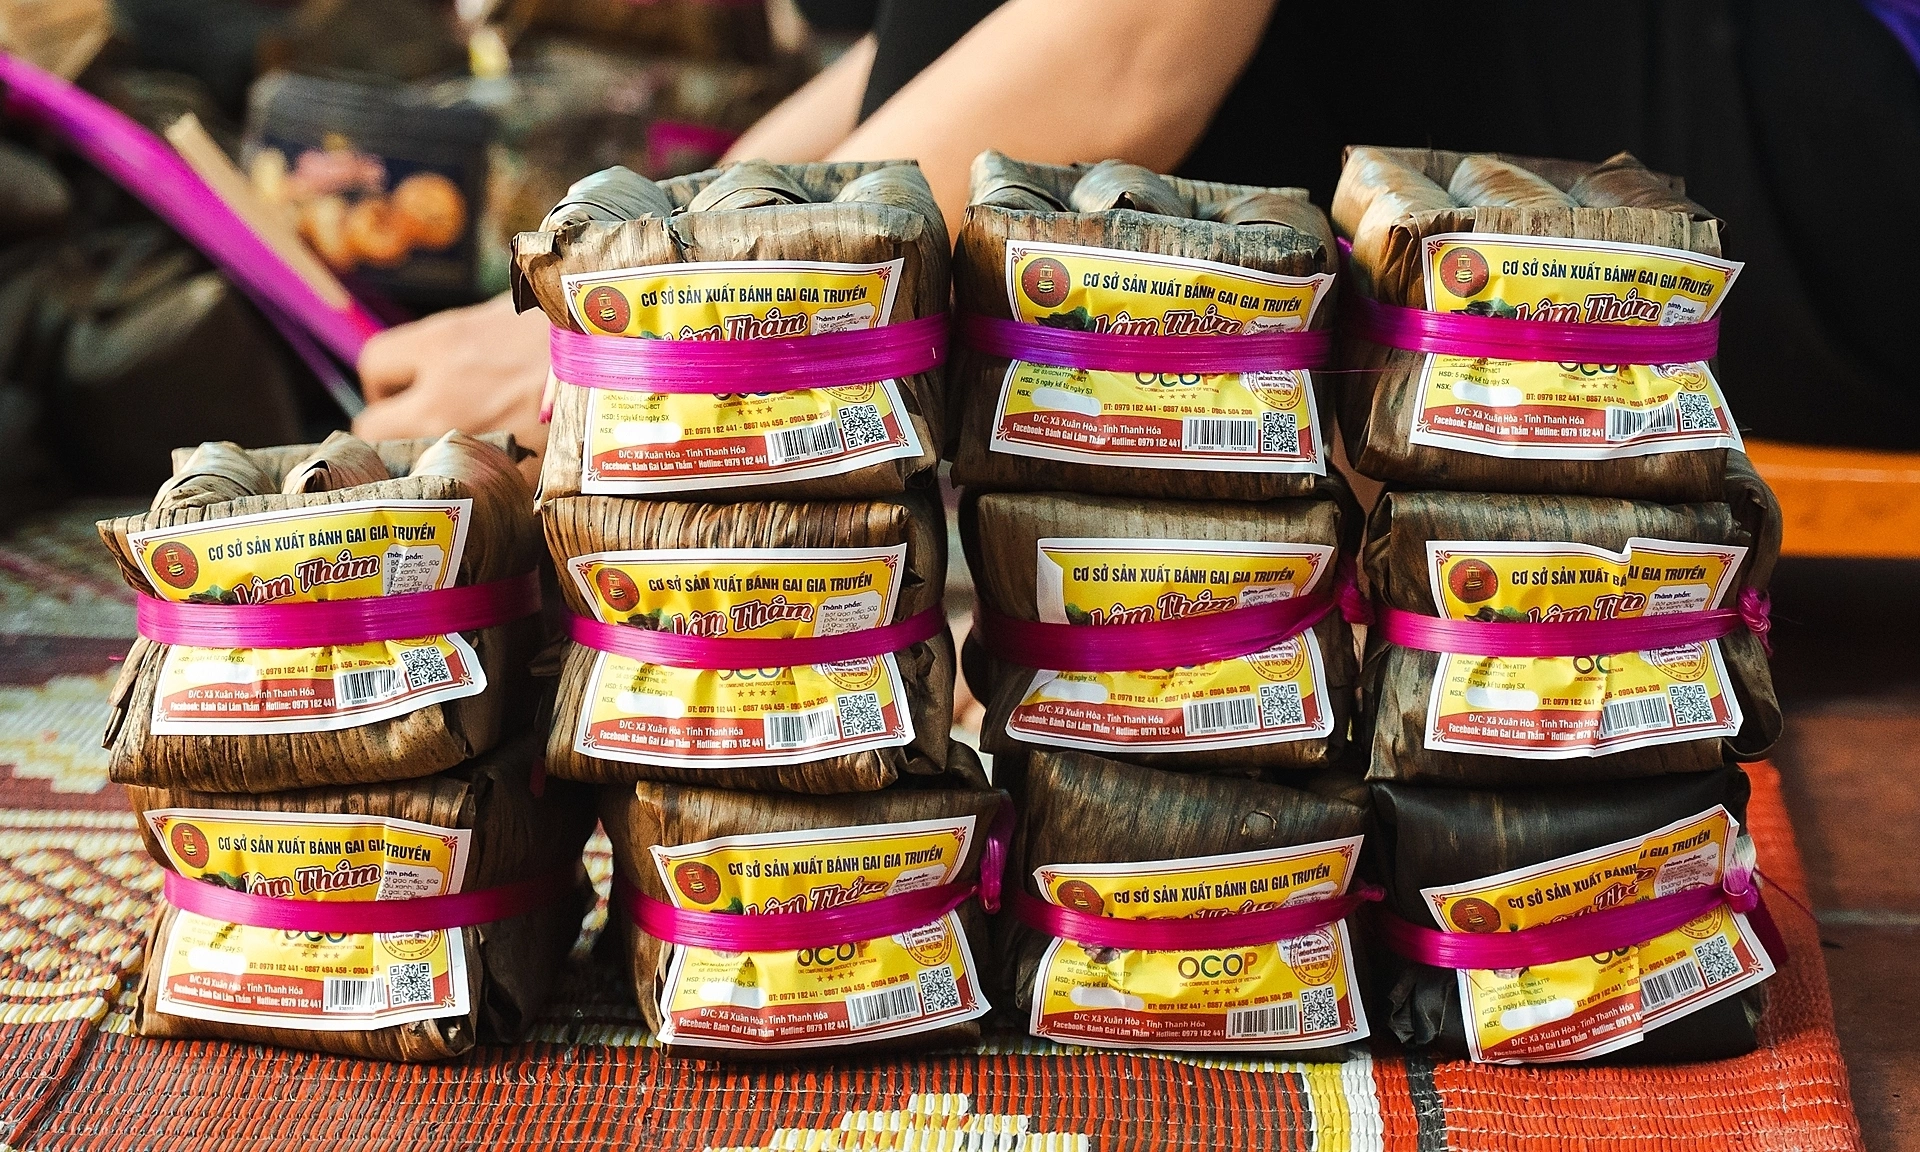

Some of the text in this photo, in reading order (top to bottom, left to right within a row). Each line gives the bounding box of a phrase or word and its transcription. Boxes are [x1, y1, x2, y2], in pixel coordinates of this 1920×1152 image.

[1502, 257, 1714, 297] CƠ SỞ SẢN XUẤT BÁNH GAI GIA TRUYỀN
[641, 283, 867, 307] CƠ SỞ SẢN XUẤT BÁNH GAI GIA TRUYỀN
[1083, 271, 1303, 312] CƠ SỞ SẢN XUẤT BÁNH GAI GIA TRUYỀN
[1114, 403, 1130, 411] 0979
[1131, 404, 1143, 412] 182
[1120, 425, 1145, 435] Thanh
[208, 522, 436, 561] CƠ SỞ SẢN XUẤT BÁNH GAI GIA TRUYỀN
[295, 549, 380, 593] Thắm
[648, 570, 873, 593] CƠ SỞ SẢN XUẤT BÁNH GAI GIA TRUYỀN
[1073, 562, 1296, 585] CƠ SỞ SẢN XUẤT BÁNH GAI GIA TRUYỀN
[1511, 564, 1706, 588] CƠ SỞ SẢN XUẤT BÁ AI GIA TRUYỀN
[730, 595, 814, 632] Thắm
[1123, 715, 1147, 724] Thanh
[218, 836, 231, 851] CƠ
[233, 834, 247, 852] SỞ
[250, 836, 273, 854] SẢN
[277, 833, 305, 855] XUẤT
[309, 835, 341, 855] BÁNH
[344, 839, 365, 854] GAI
[384, 842, 431, 862] TRUYỀN
[728, 844, 944, 878] CƠ SỞ SẢN XUẤT BÁNH GAI GIA TRUYỀN
[1507, 829, 1711, 910] CƠ SỞ SẢN XUẤT BÁNH GIA TRUYỀN
[295, 859, 381, 895] Thắm
[1113, 863, 1330, 904] CƠ SỞ SẢN XUẤT BÁNH GAI GIA TRUYỀN
[797, 943, 869, 966] OCOP
[1178, 952, 1258, 979] OCOP
[788, 1013, 811, 1023] Thanh
[1164, 1020, 1189, 1029] Thanh
[1595, 1008, 1619, 1022] Thanh
